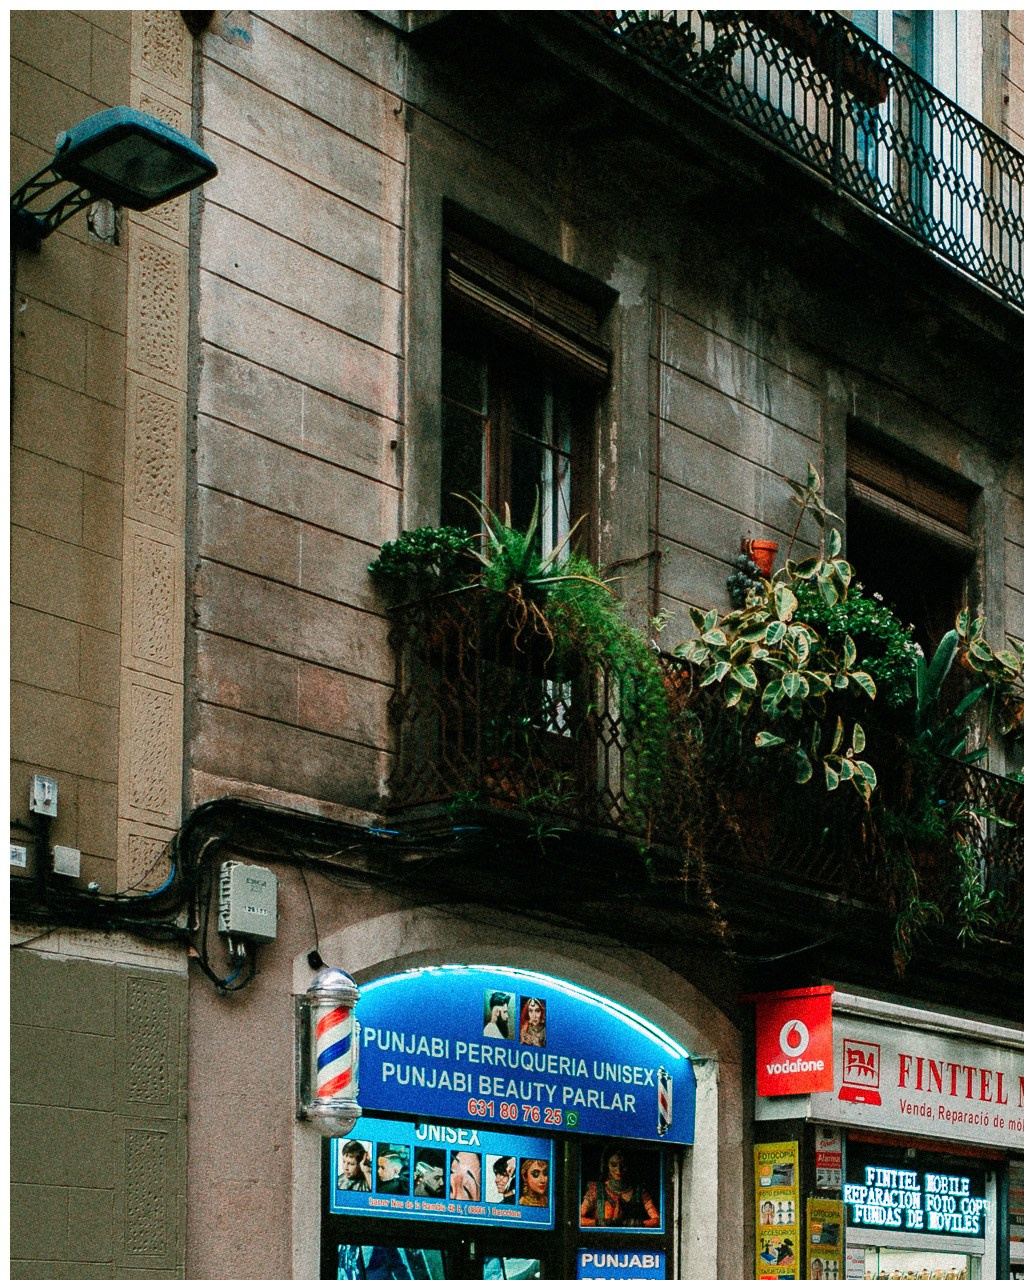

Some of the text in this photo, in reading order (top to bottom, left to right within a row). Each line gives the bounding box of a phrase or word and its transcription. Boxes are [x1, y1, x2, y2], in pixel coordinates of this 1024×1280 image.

[364, 1027, 655, 1086] PUNJABI PERRUQUERIA UNISEX
[766, 1059, 825, 1075] vodafone
[382, 1061, 636, 1113] PUNJABI BEAUTY PARLAR
[897, 1053, 1009, 1106] FINTTEL
[468, 1097, 562, 1125] 631 80 76 25
[899, 1098, 935, 1120] Venda,
[938, 1107, 989, 1127] Reparació
[993, 1114, 1005, 1128] de
[415, 1123, 481, 1147] UNISEX
[758, 1151, 795, 1160] FOTOCOPIA
[865, 1166, 970, 1196] FINTTEL MOBILE
[843, 1184, 921, 1209] REPARACION
[924, 1194, 957, 1212] FOTO
[853, 1204, 980, 1233] FUNDAS DE MOVILES
[581, 1253, 660, 1268] PUNJABI
